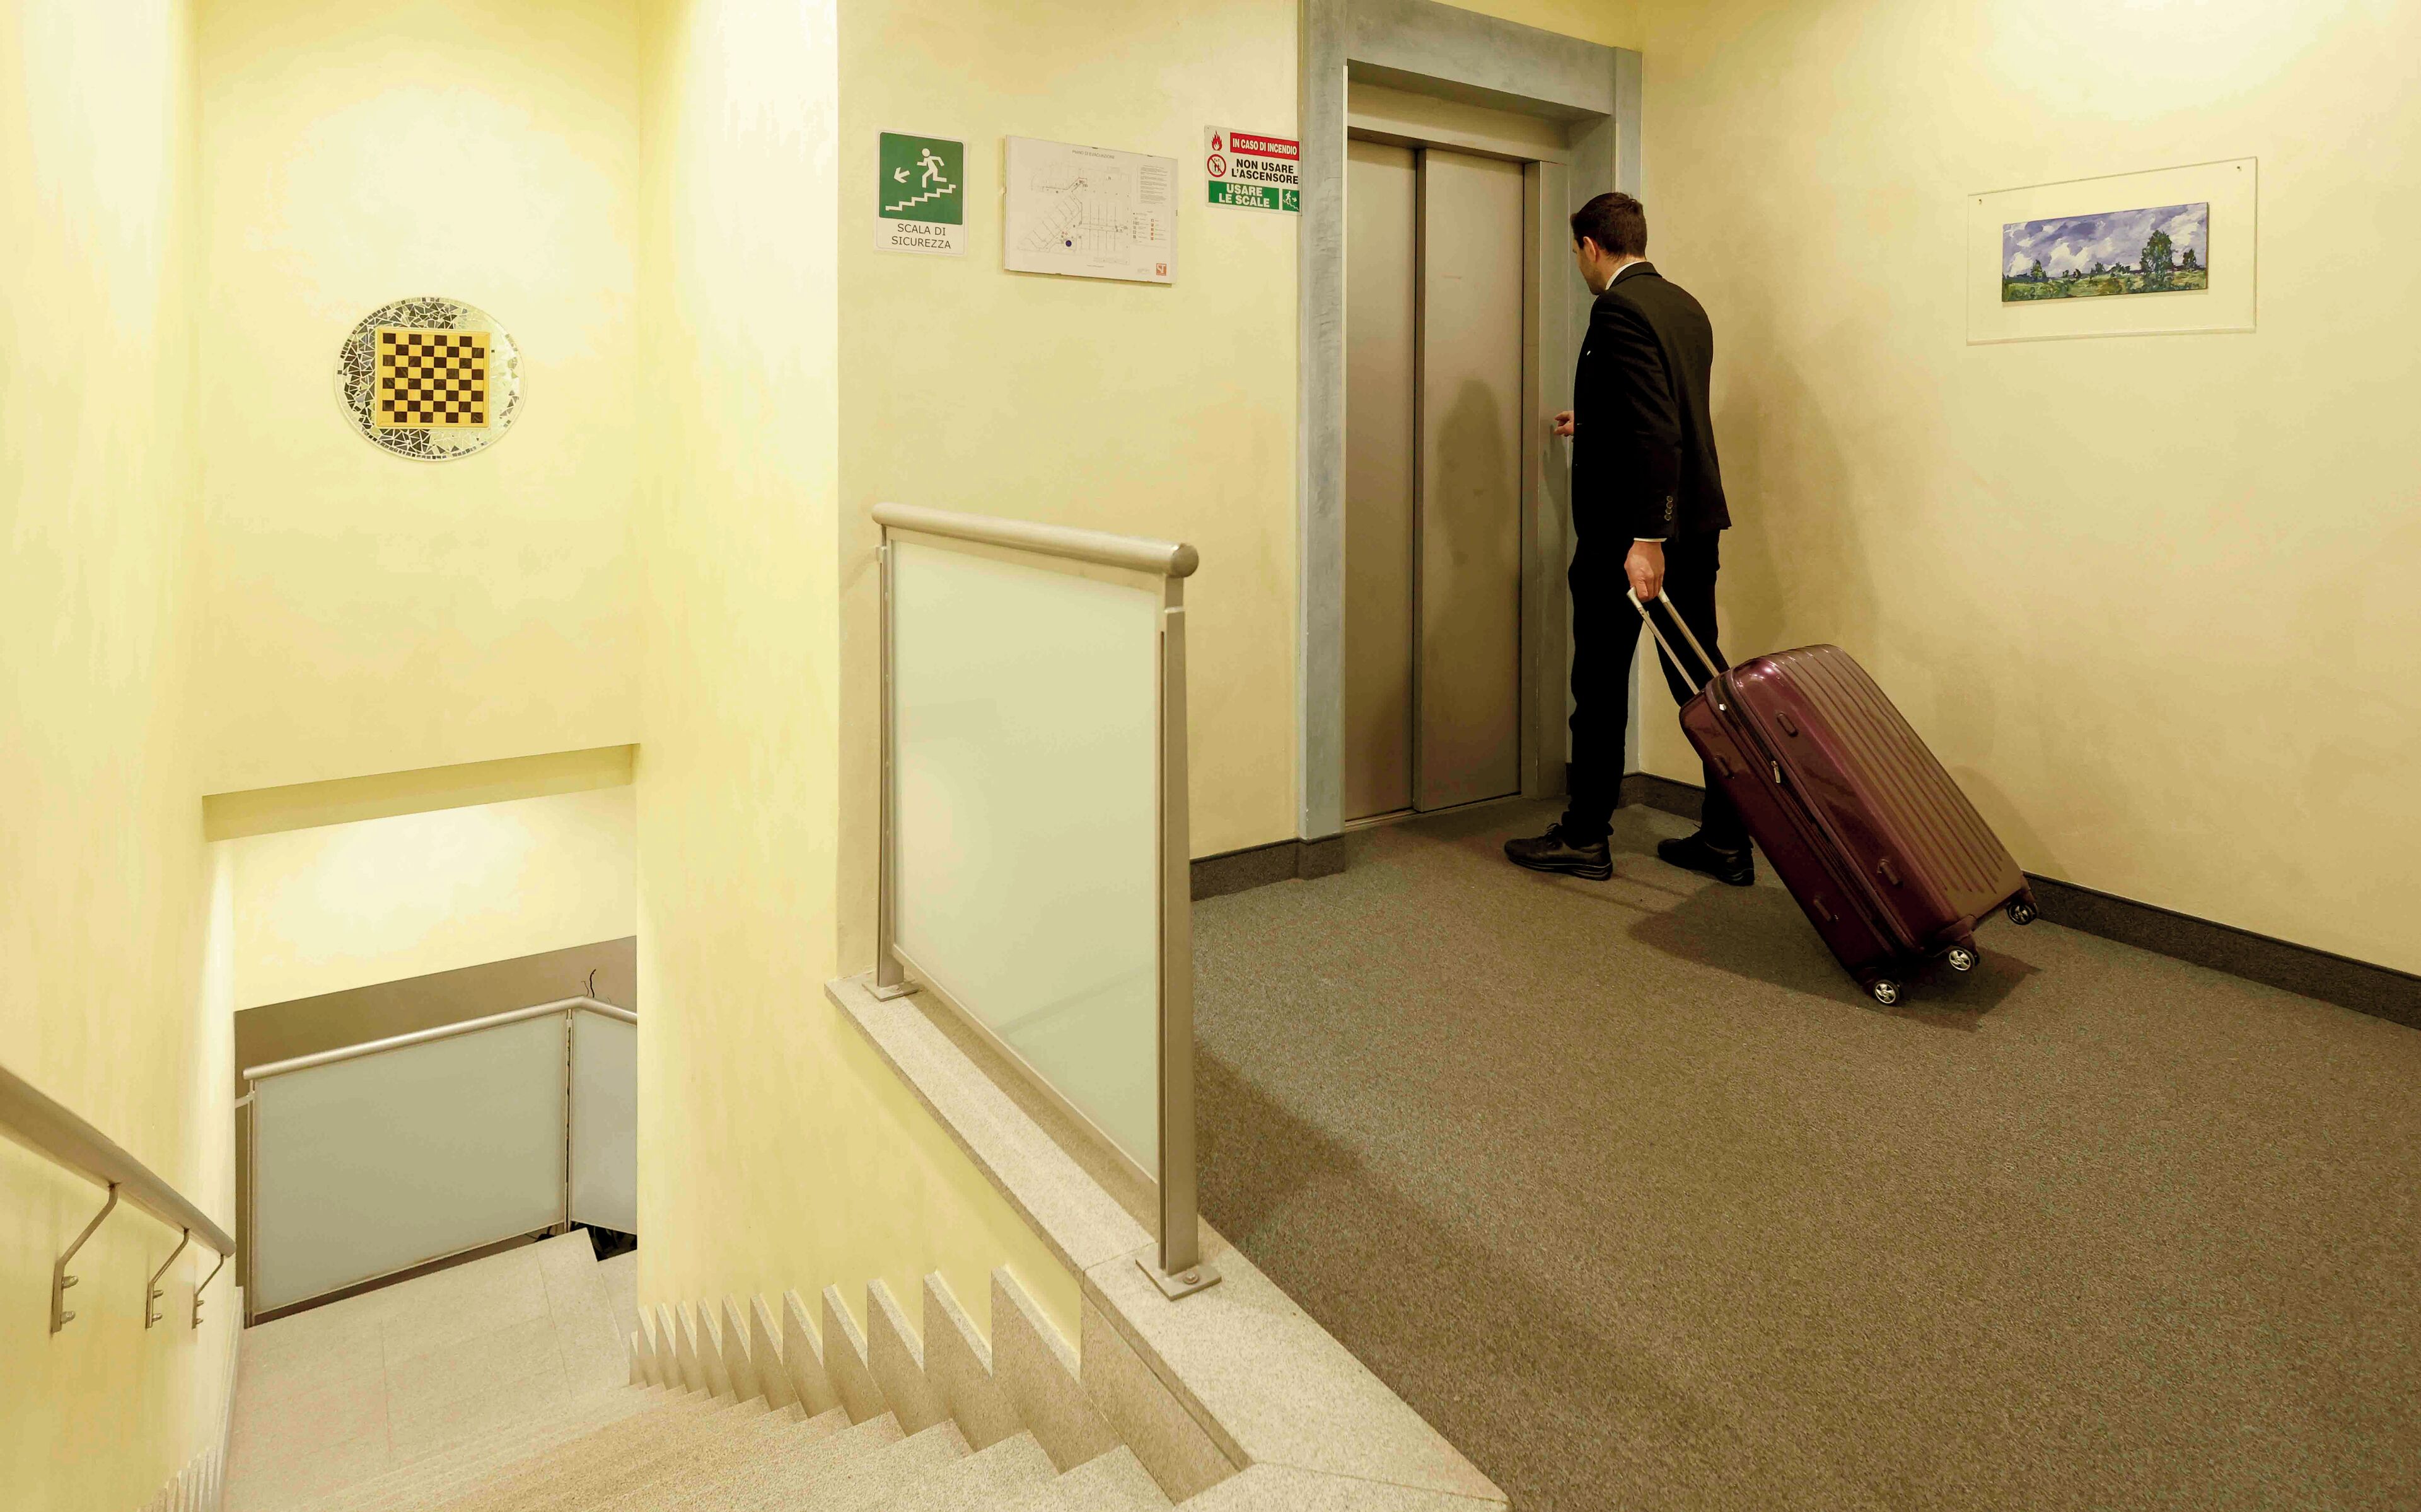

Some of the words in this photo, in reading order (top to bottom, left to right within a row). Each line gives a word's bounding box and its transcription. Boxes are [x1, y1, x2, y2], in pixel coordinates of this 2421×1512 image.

[1233, 138, 1240, 147] IN
[1241, 139, 1258, 151] CASO
[1260, 141, 1266, 151] DI
[1267, 142, 1298, 155] INCENDIO
[1236, 159, 1258, 170] NON
[1262, 162, 1294, 174] USARE
[1231, 168, 1299, 185] L'ASCENSORE
[1226, 183, 1263, 197] USARE
[1219, 193, 1233, 204] LE
[1235, 195, 1270, 207] SCALE
[897, 223, 931, 234] SCALA
[934, 226, 946, 236] DI
[891, 236, 951, 249] SICUREZZA
